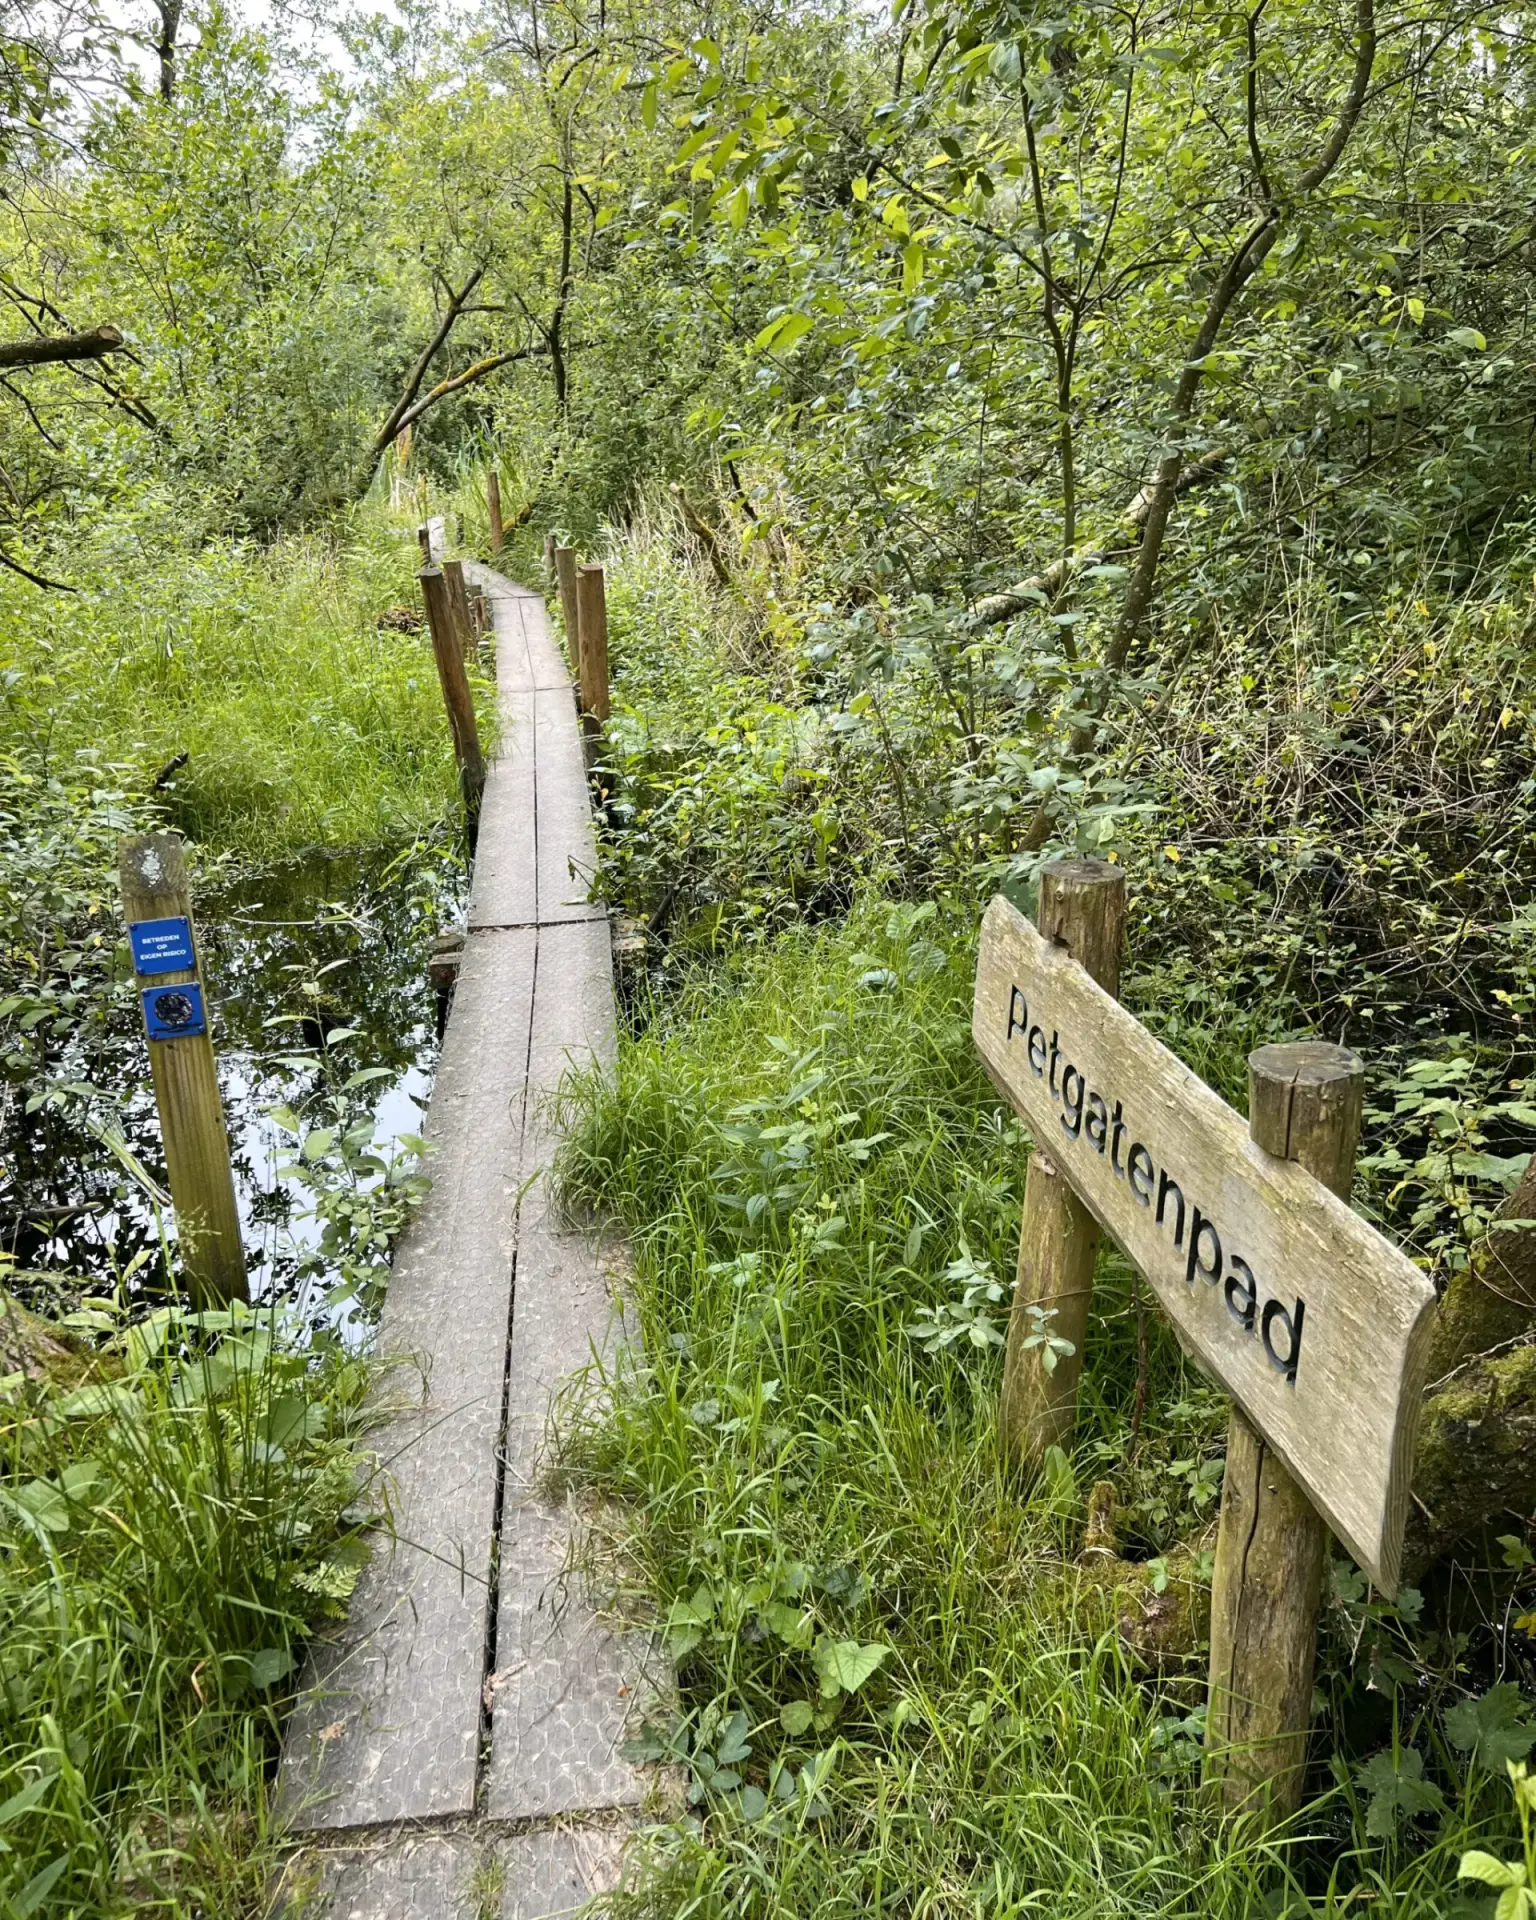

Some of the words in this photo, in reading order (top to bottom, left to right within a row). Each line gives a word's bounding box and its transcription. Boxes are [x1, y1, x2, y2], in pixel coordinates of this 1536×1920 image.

[142, 934, 180, 944] BETREDEN
[140, 952, 162, 960] EIGEN
[1007, 984, 1304, 1387] Petgatenpad
